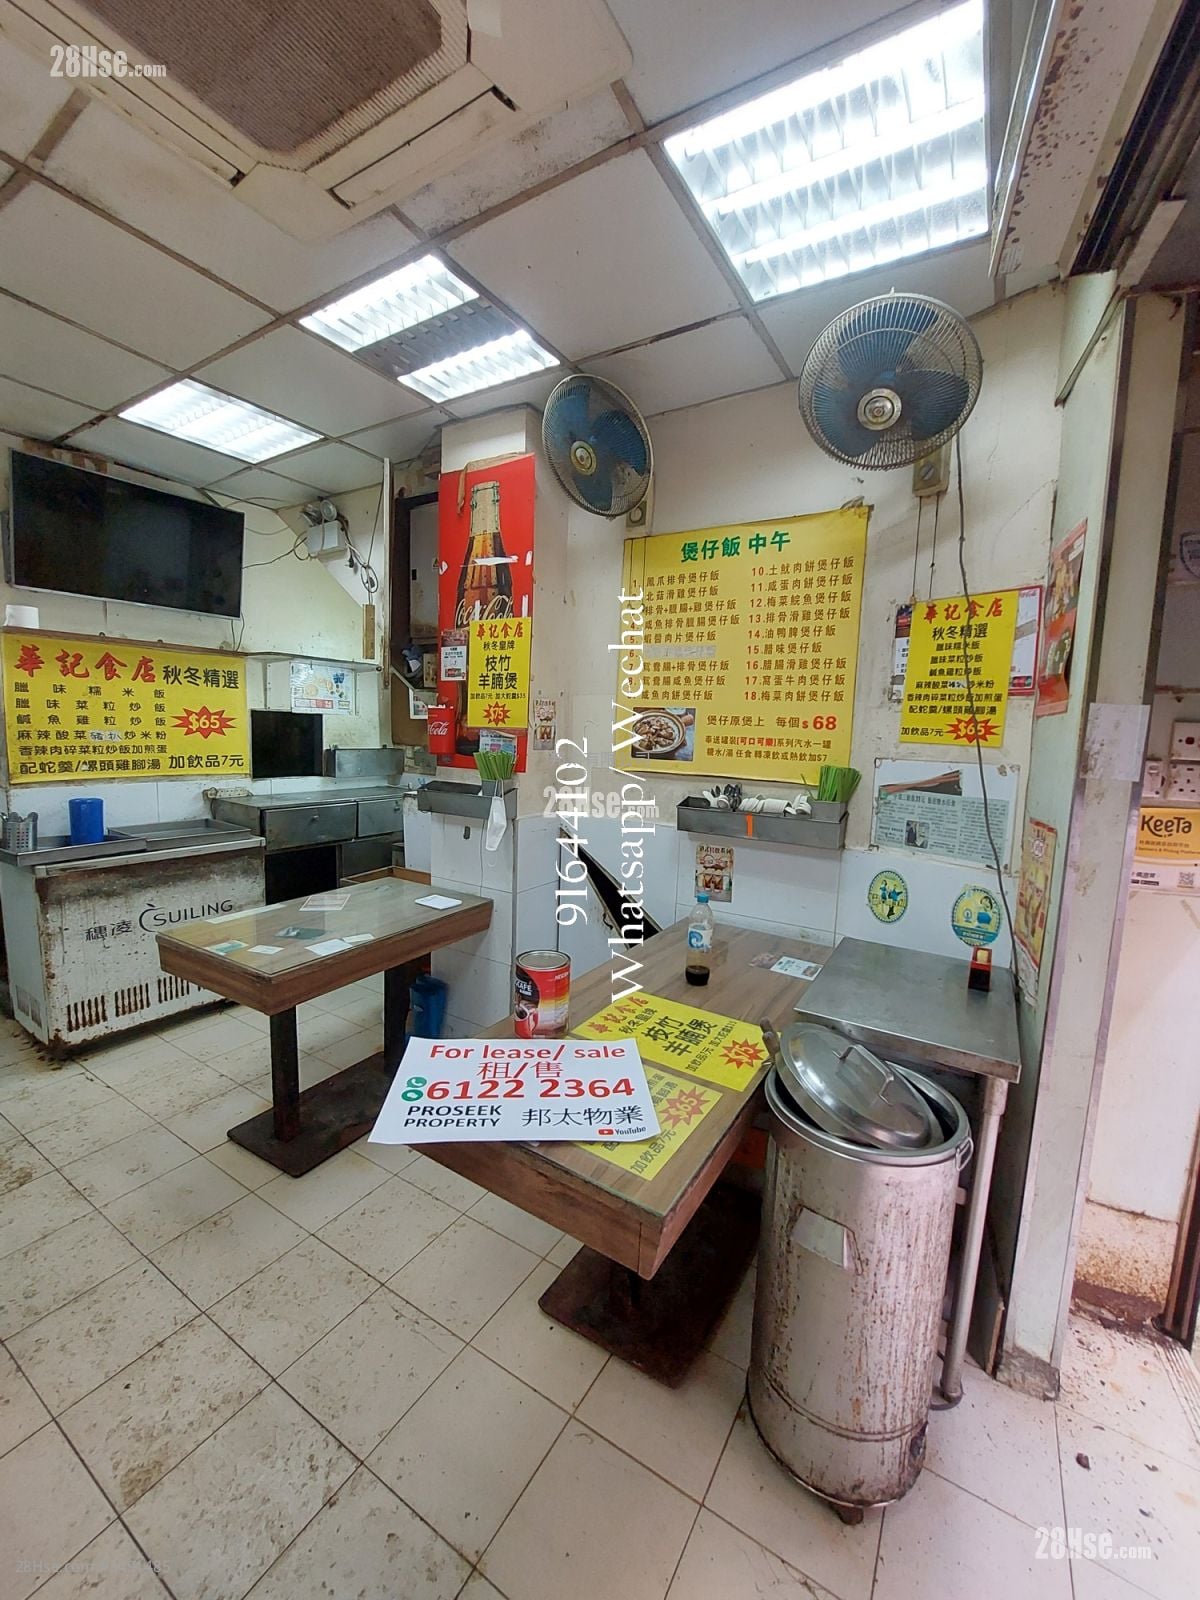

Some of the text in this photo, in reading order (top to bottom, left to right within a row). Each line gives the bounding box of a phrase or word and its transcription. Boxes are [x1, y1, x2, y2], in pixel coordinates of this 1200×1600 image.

[680, 530, 791, 562] 煲仔飯 中午
[924, 598, 1003, 624] 華記食店
[476, 621, 524, 640] 華記食店
[932, 623, 988, 640] 秋冬精選
[14, 644, 156, 683] 華記食店
[485, 654, 512, 673] 枝竹
[162, 665, 240, 690] 秋冬精選
[478, 672, 518, 690] 羊腩煲
[188, 712, 221, 731] $65
[168, 753, 244, 769] 加飲品7元
[1141, 815, 1192, 838] KeeTa
[153, 899, 234, 926] SUILING
[429, 1044, 626, 1060] For lease/ sale
[477, 1061, 563, 1080] 租/售
[426, 1078, 635, 1100] 6122 2364
[407, 1104, 503, 1117] PROSEEK
[522, 1105, 644, 1127] 邦太物業
[403, 1117, 502, 1128] PROPERTY
[614, 1125, 647, 1136] YouTube
